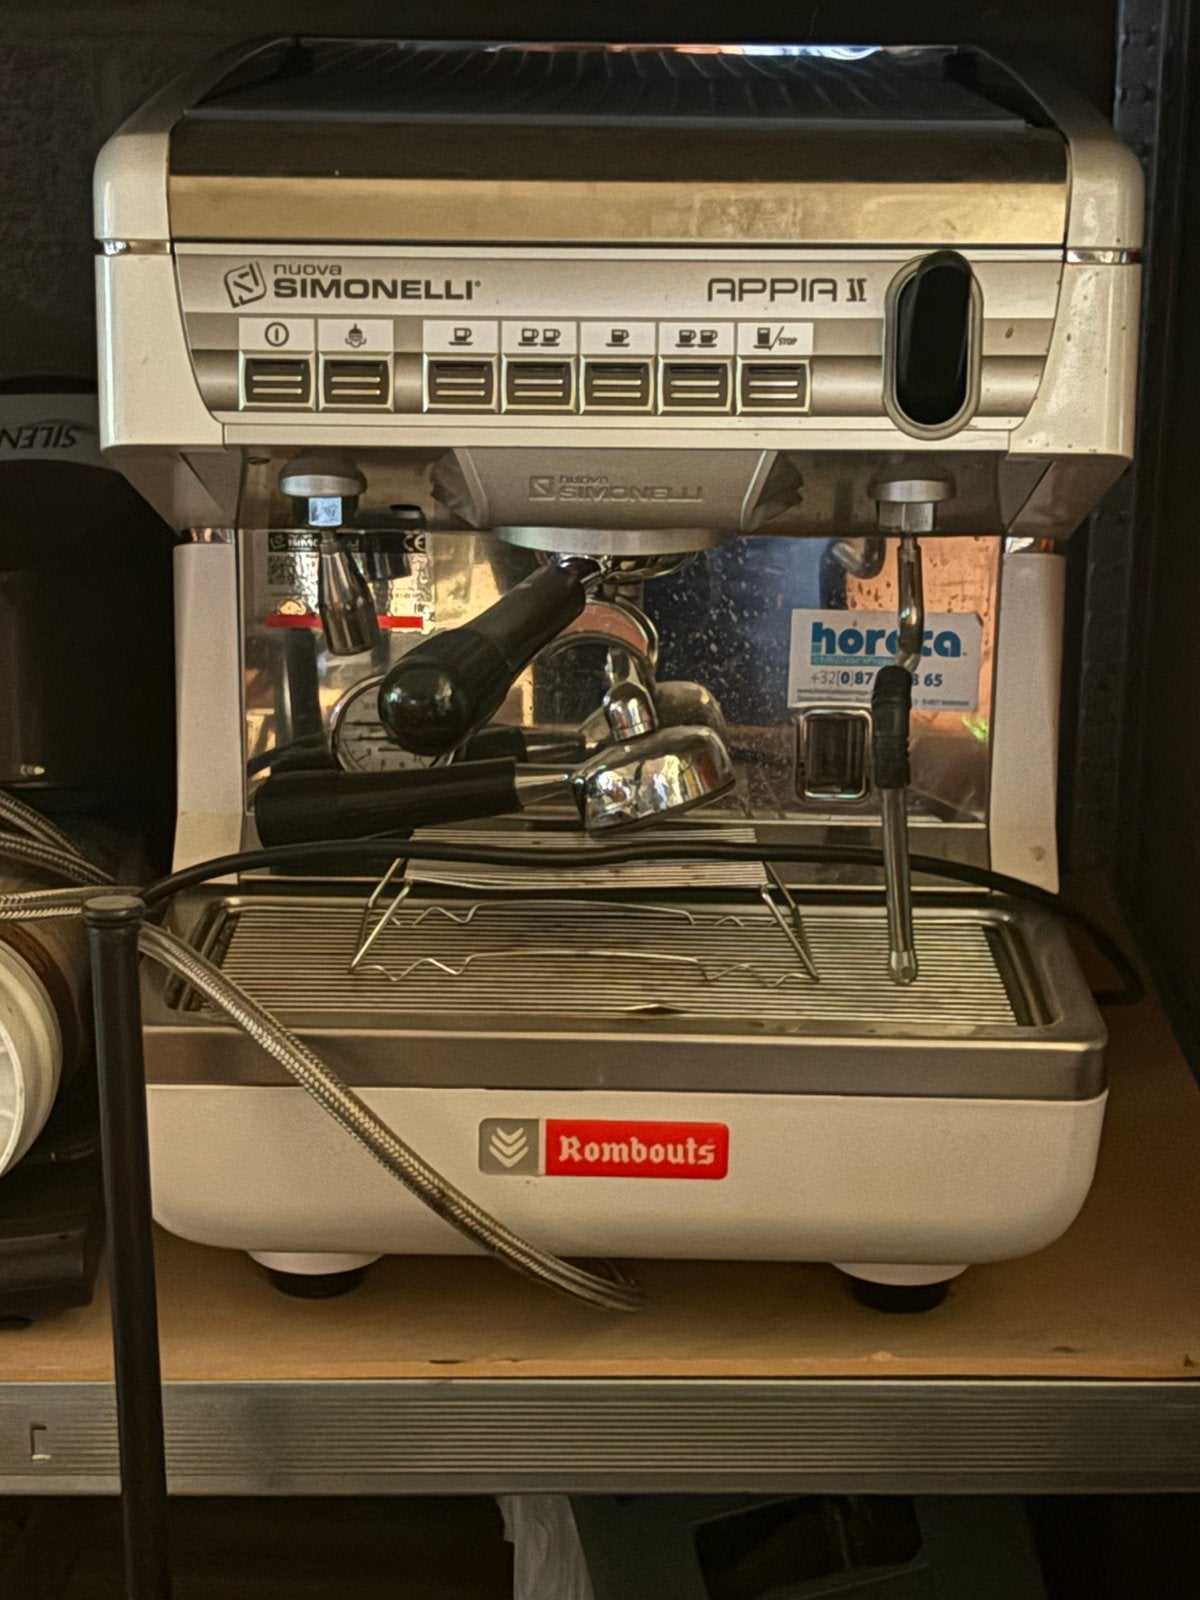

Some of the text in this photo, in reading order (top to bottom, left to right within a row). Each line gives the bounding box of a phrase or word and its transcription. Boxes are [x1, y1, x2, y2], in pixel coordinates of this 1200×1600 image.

[273, 263, 342, 275] nuova
[273, 278, 473, 300] SIMONELLI
[707, 278, 838, 301] APPIA
[558, 485, 703, 502] SIMONELLI
[924, 673, 943, 687] 65
[558, 1134, 716, 1165] Rombouts
